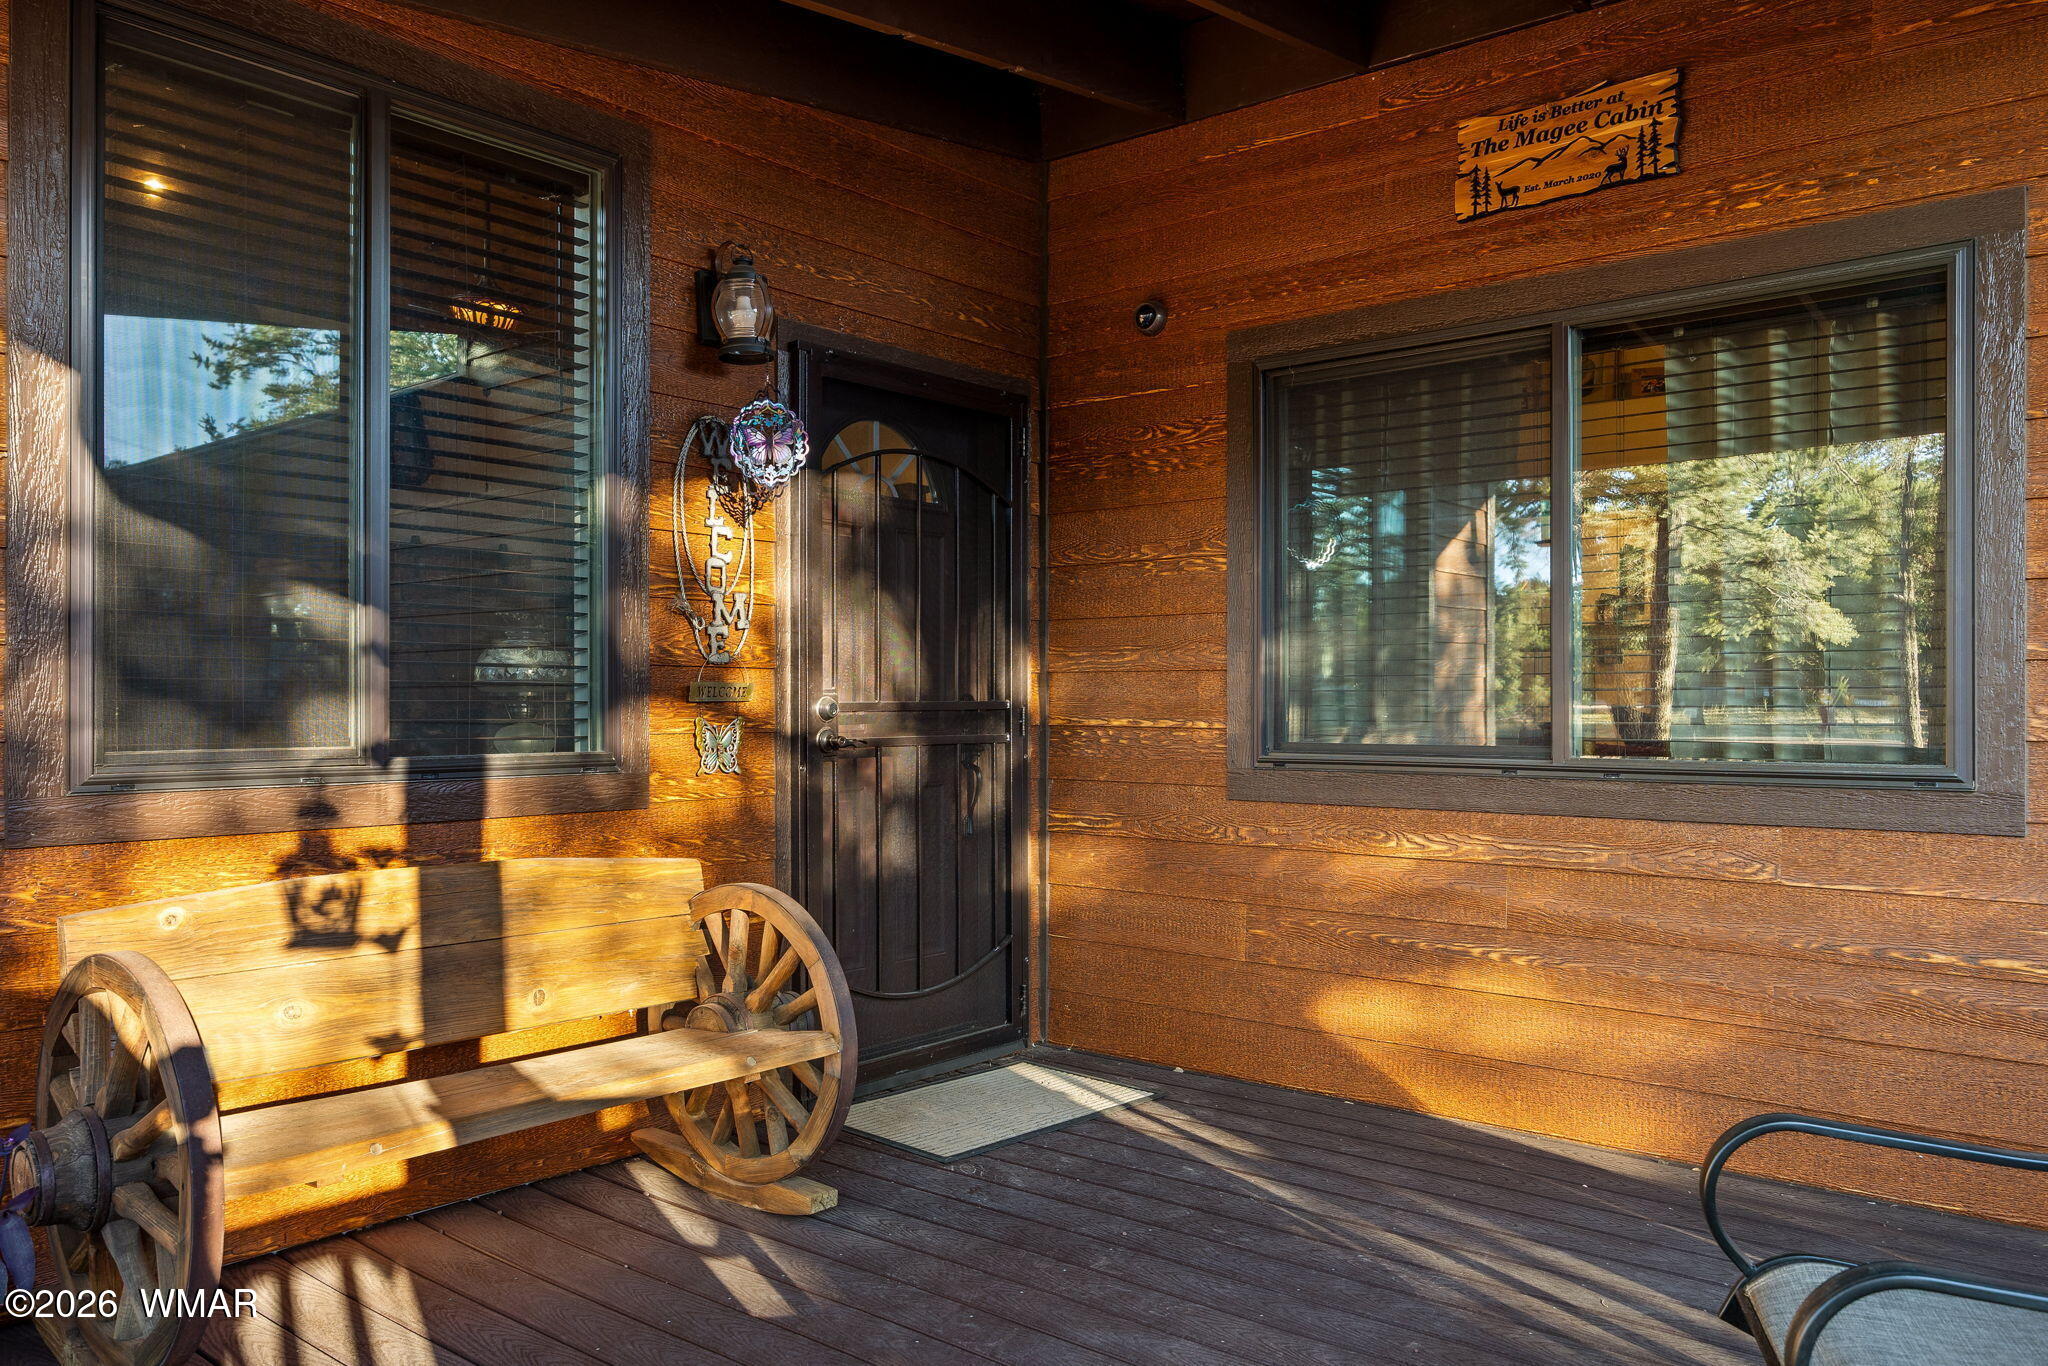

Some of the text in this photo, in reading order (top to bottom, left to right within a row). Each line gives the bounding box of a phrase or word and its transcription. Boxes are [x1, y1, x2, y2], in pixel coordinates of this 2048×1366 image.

[1497, 91, 1626, 132] Life is Better at
[1471, 100, 1664, 158] The Magee Cabin
[1523, 171, 1602, 193] Est. March 2020
[697, 686, 748, 698] WELCOME
